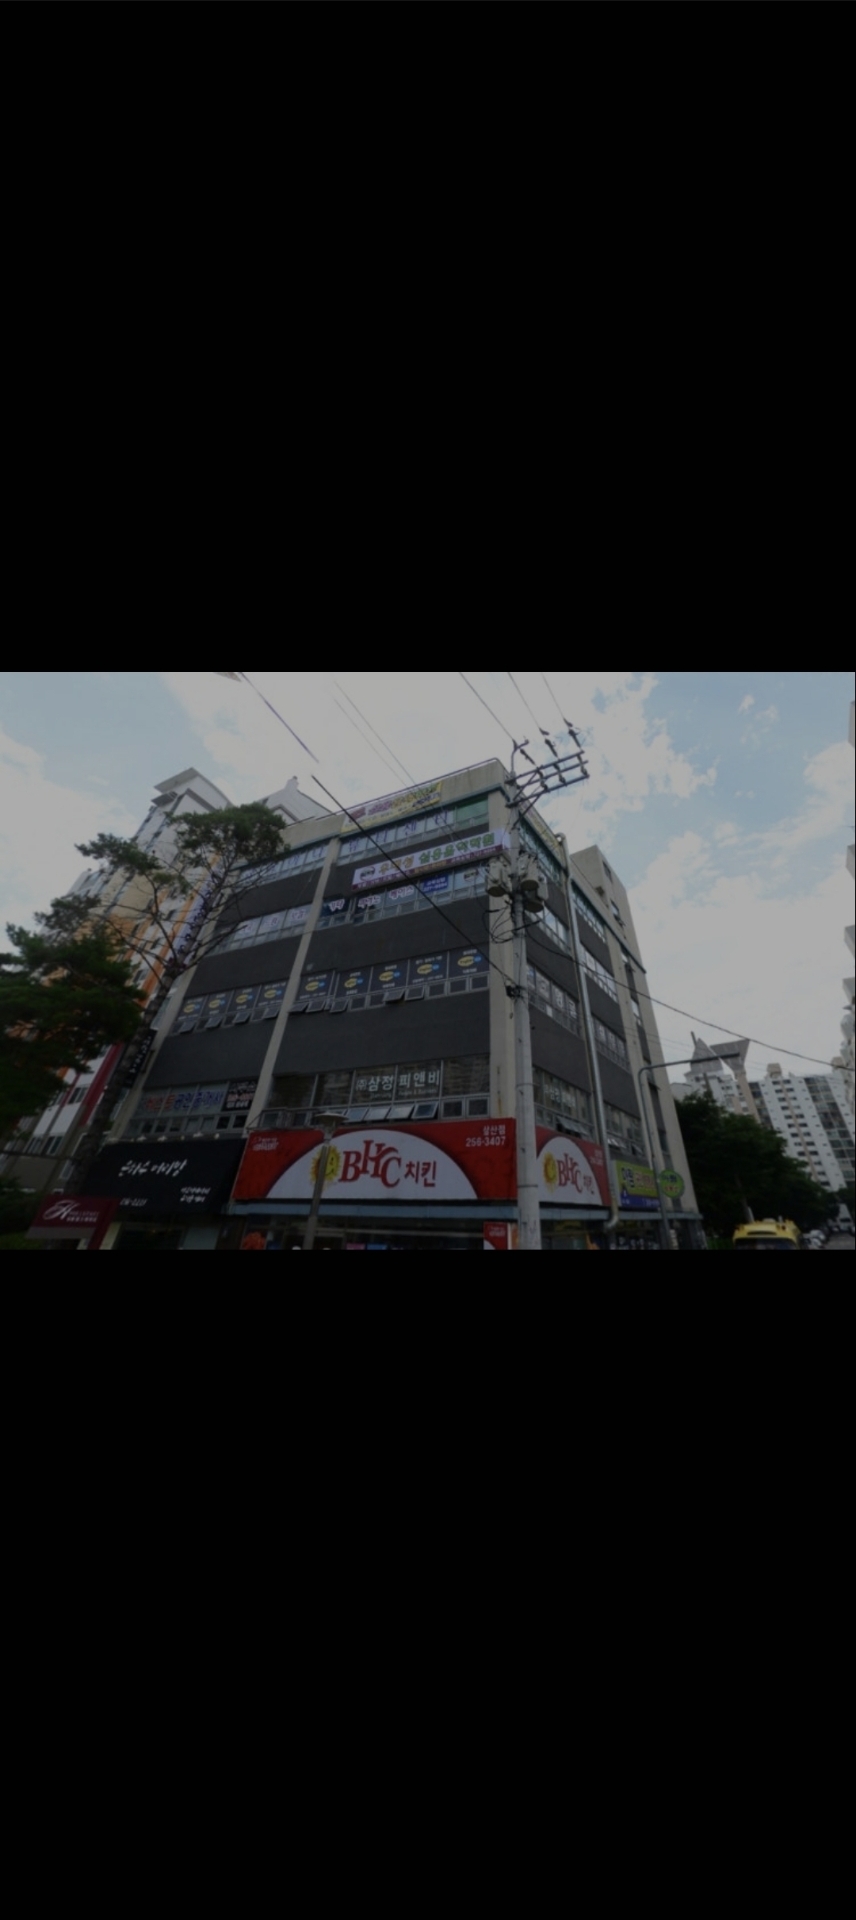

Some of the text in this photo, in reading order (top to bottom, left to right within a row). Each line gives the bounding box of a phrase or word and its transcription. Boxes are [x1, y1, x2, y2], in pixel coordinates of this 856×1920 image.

[419, 833, 495, 865] 실용음악학원
[466, 1136, 507, 1148] 256-3407
[341, 1139, 437, 1188] BHC 치킨
[557, 1152, 582, 1193] BHC
